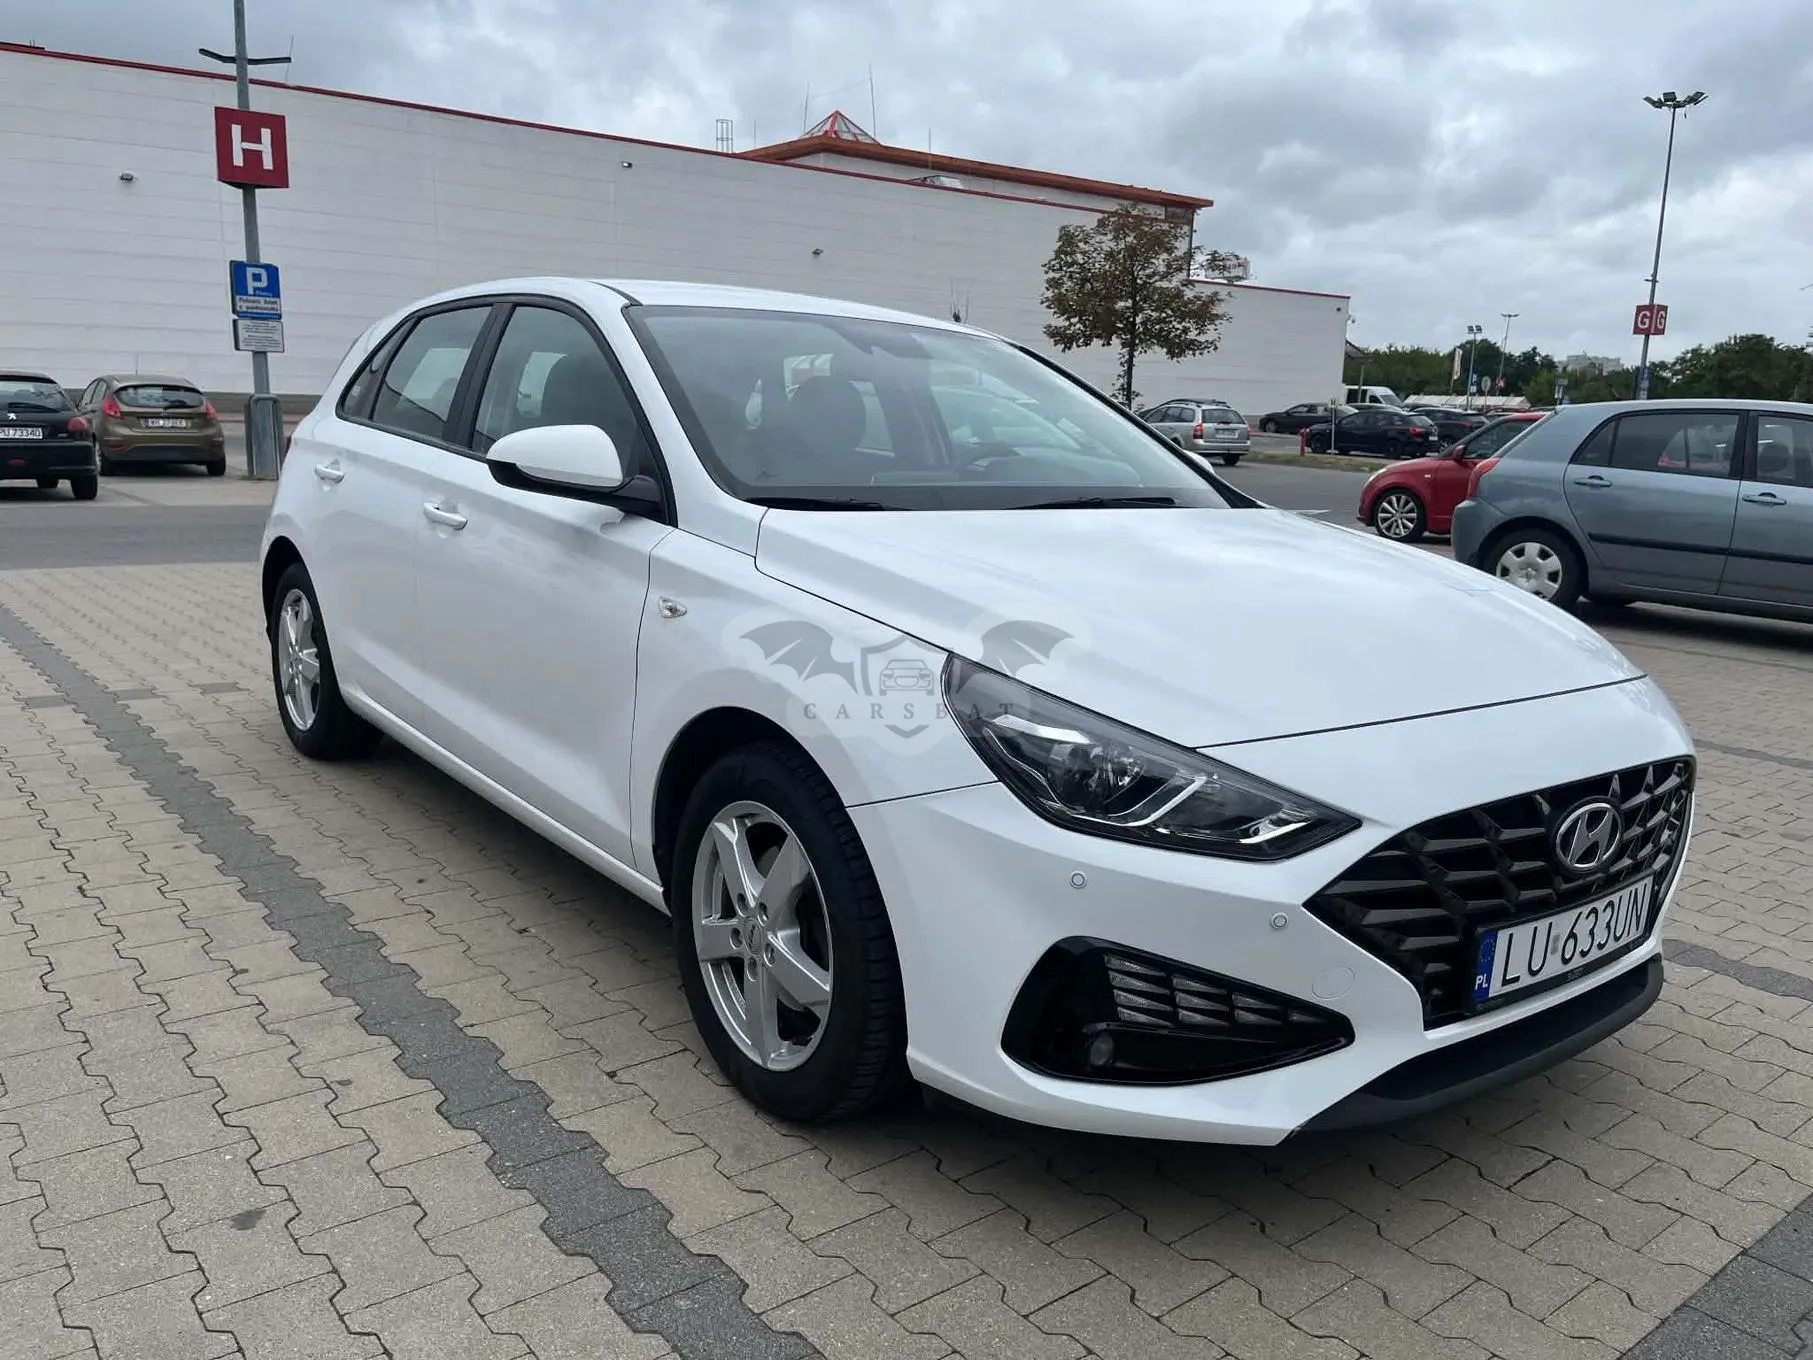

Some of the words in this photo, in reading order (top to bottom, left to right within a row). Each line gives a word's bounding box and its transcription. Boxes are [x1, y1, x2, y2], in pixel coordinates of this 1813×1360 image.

[231, 123, 274, 171] H
[245, 266, 268, 295] P
[1637, 310, 1651, 329] G
[1656, 310, 1666, 329] G
[1501, 922, 1553, 987] LU
[1561, 883, 1648, 965] 633UN
[1474, 974, 1488, 991] PL
